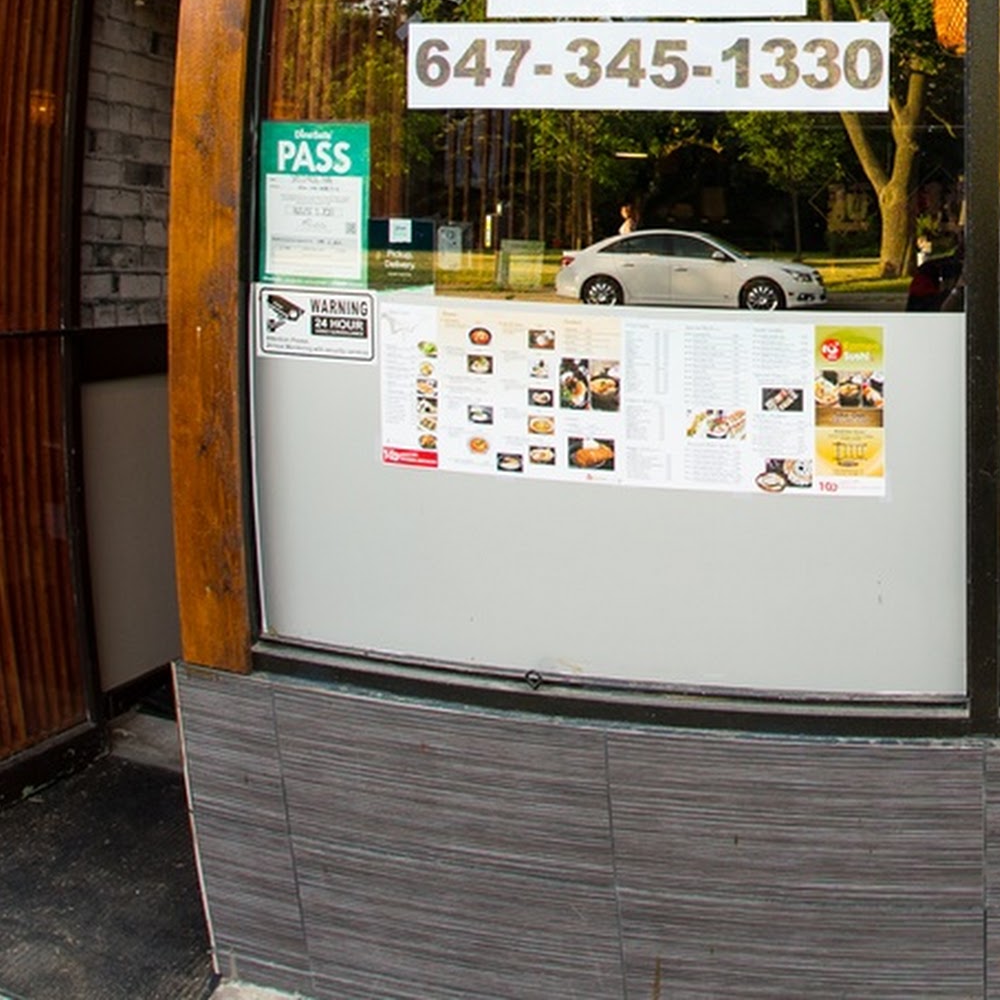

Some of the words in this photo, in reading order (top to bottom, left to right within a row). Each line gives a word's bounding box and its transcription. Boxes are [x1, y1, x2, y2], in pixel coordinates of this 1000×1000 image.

[415, 37, 885, 91] 647-345-1330
[277, 139, 352, 174] PASS
[310, 298, 369, 317] WARNING
[314, 317, 328, 329] 24
[329, 318, 364, 332] HOUR
